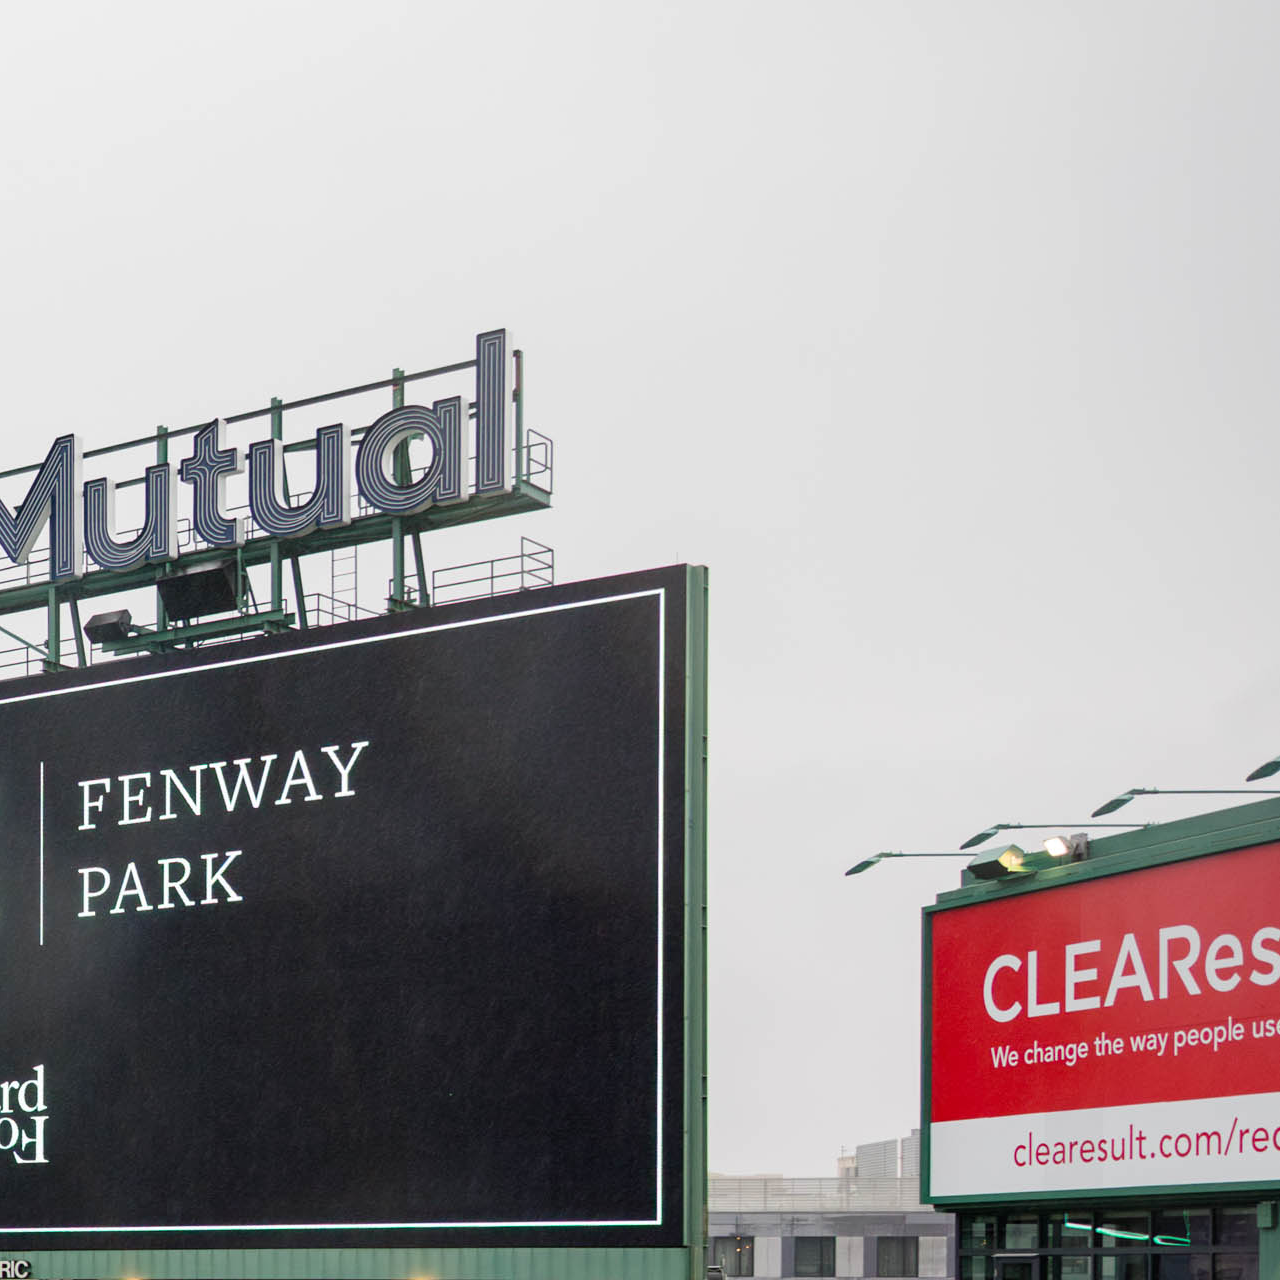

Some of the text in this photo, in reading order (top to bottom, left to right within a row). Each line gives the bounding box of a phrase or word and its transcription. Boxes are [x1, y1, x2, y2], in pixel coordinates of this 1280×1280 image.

[78, 741, 370, 831] FENWAY
[78, 850, 243, 918] PARK
[983, 924, 1280, 1023] CLEARes
[991, 1046, 1019, 1068] We
[1024, 1040, 1089, 1066] change
[1094, 1032, 1124, 1056] the
[1130, 1031, 1168, 1057] way
[1174, 1016, 1245, 1056] people
